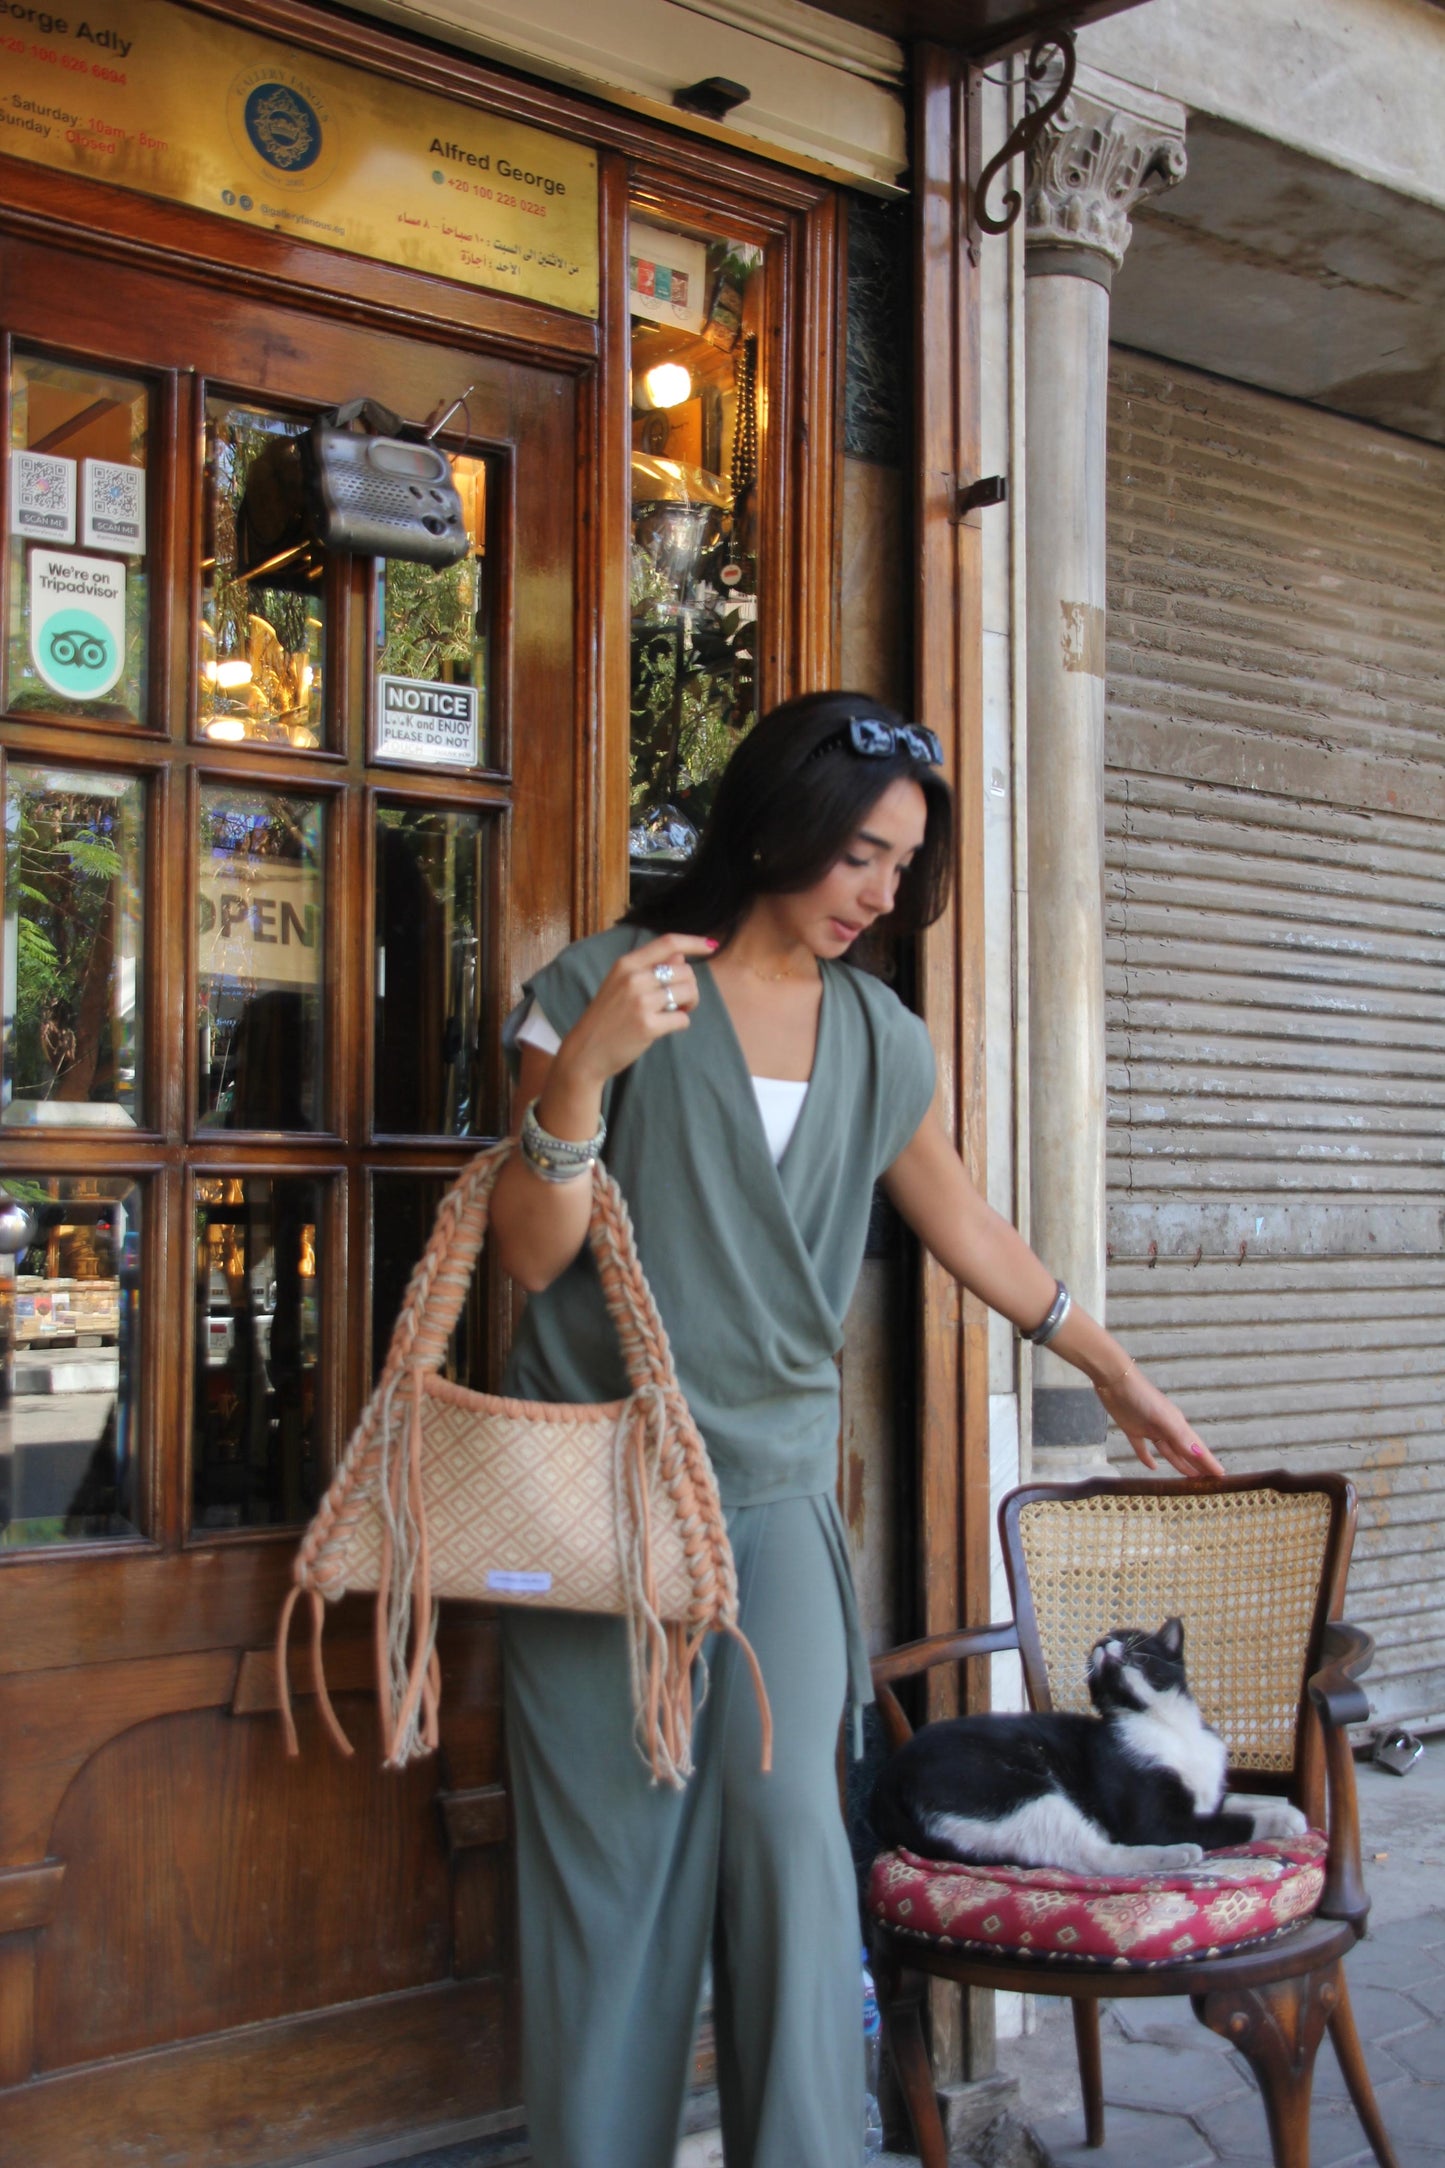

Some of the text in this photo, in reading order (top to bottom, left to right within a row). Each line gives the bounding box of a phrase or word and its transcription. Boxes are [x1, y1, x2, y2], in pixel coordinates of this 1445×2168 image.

[75, 21, 133, 58] Adly
[88, 118, 125, 139] 10am
[65, 129, 116, 154] Closed
[429, 138, 566, 196] Alfred George
[447, 178, 469, 193] +20
[473, 185, 493, 200] 100
[24, 513, 64, 528] SCAN ME
[97, 521, 136, 535] SCAN ME
[48, 562, 110, 585] We're on
[39, 575, 119, 599] Tripadvisor
[388, 687, 468, 718] NOTICE
[417, 718, 435, 732] and
[438, 720, 472, 737] ENJOY
[385, 728, 424, 744] PLEASE
[426, 734, 443, 746] DO
[446, 737, 470, 751] NOT
